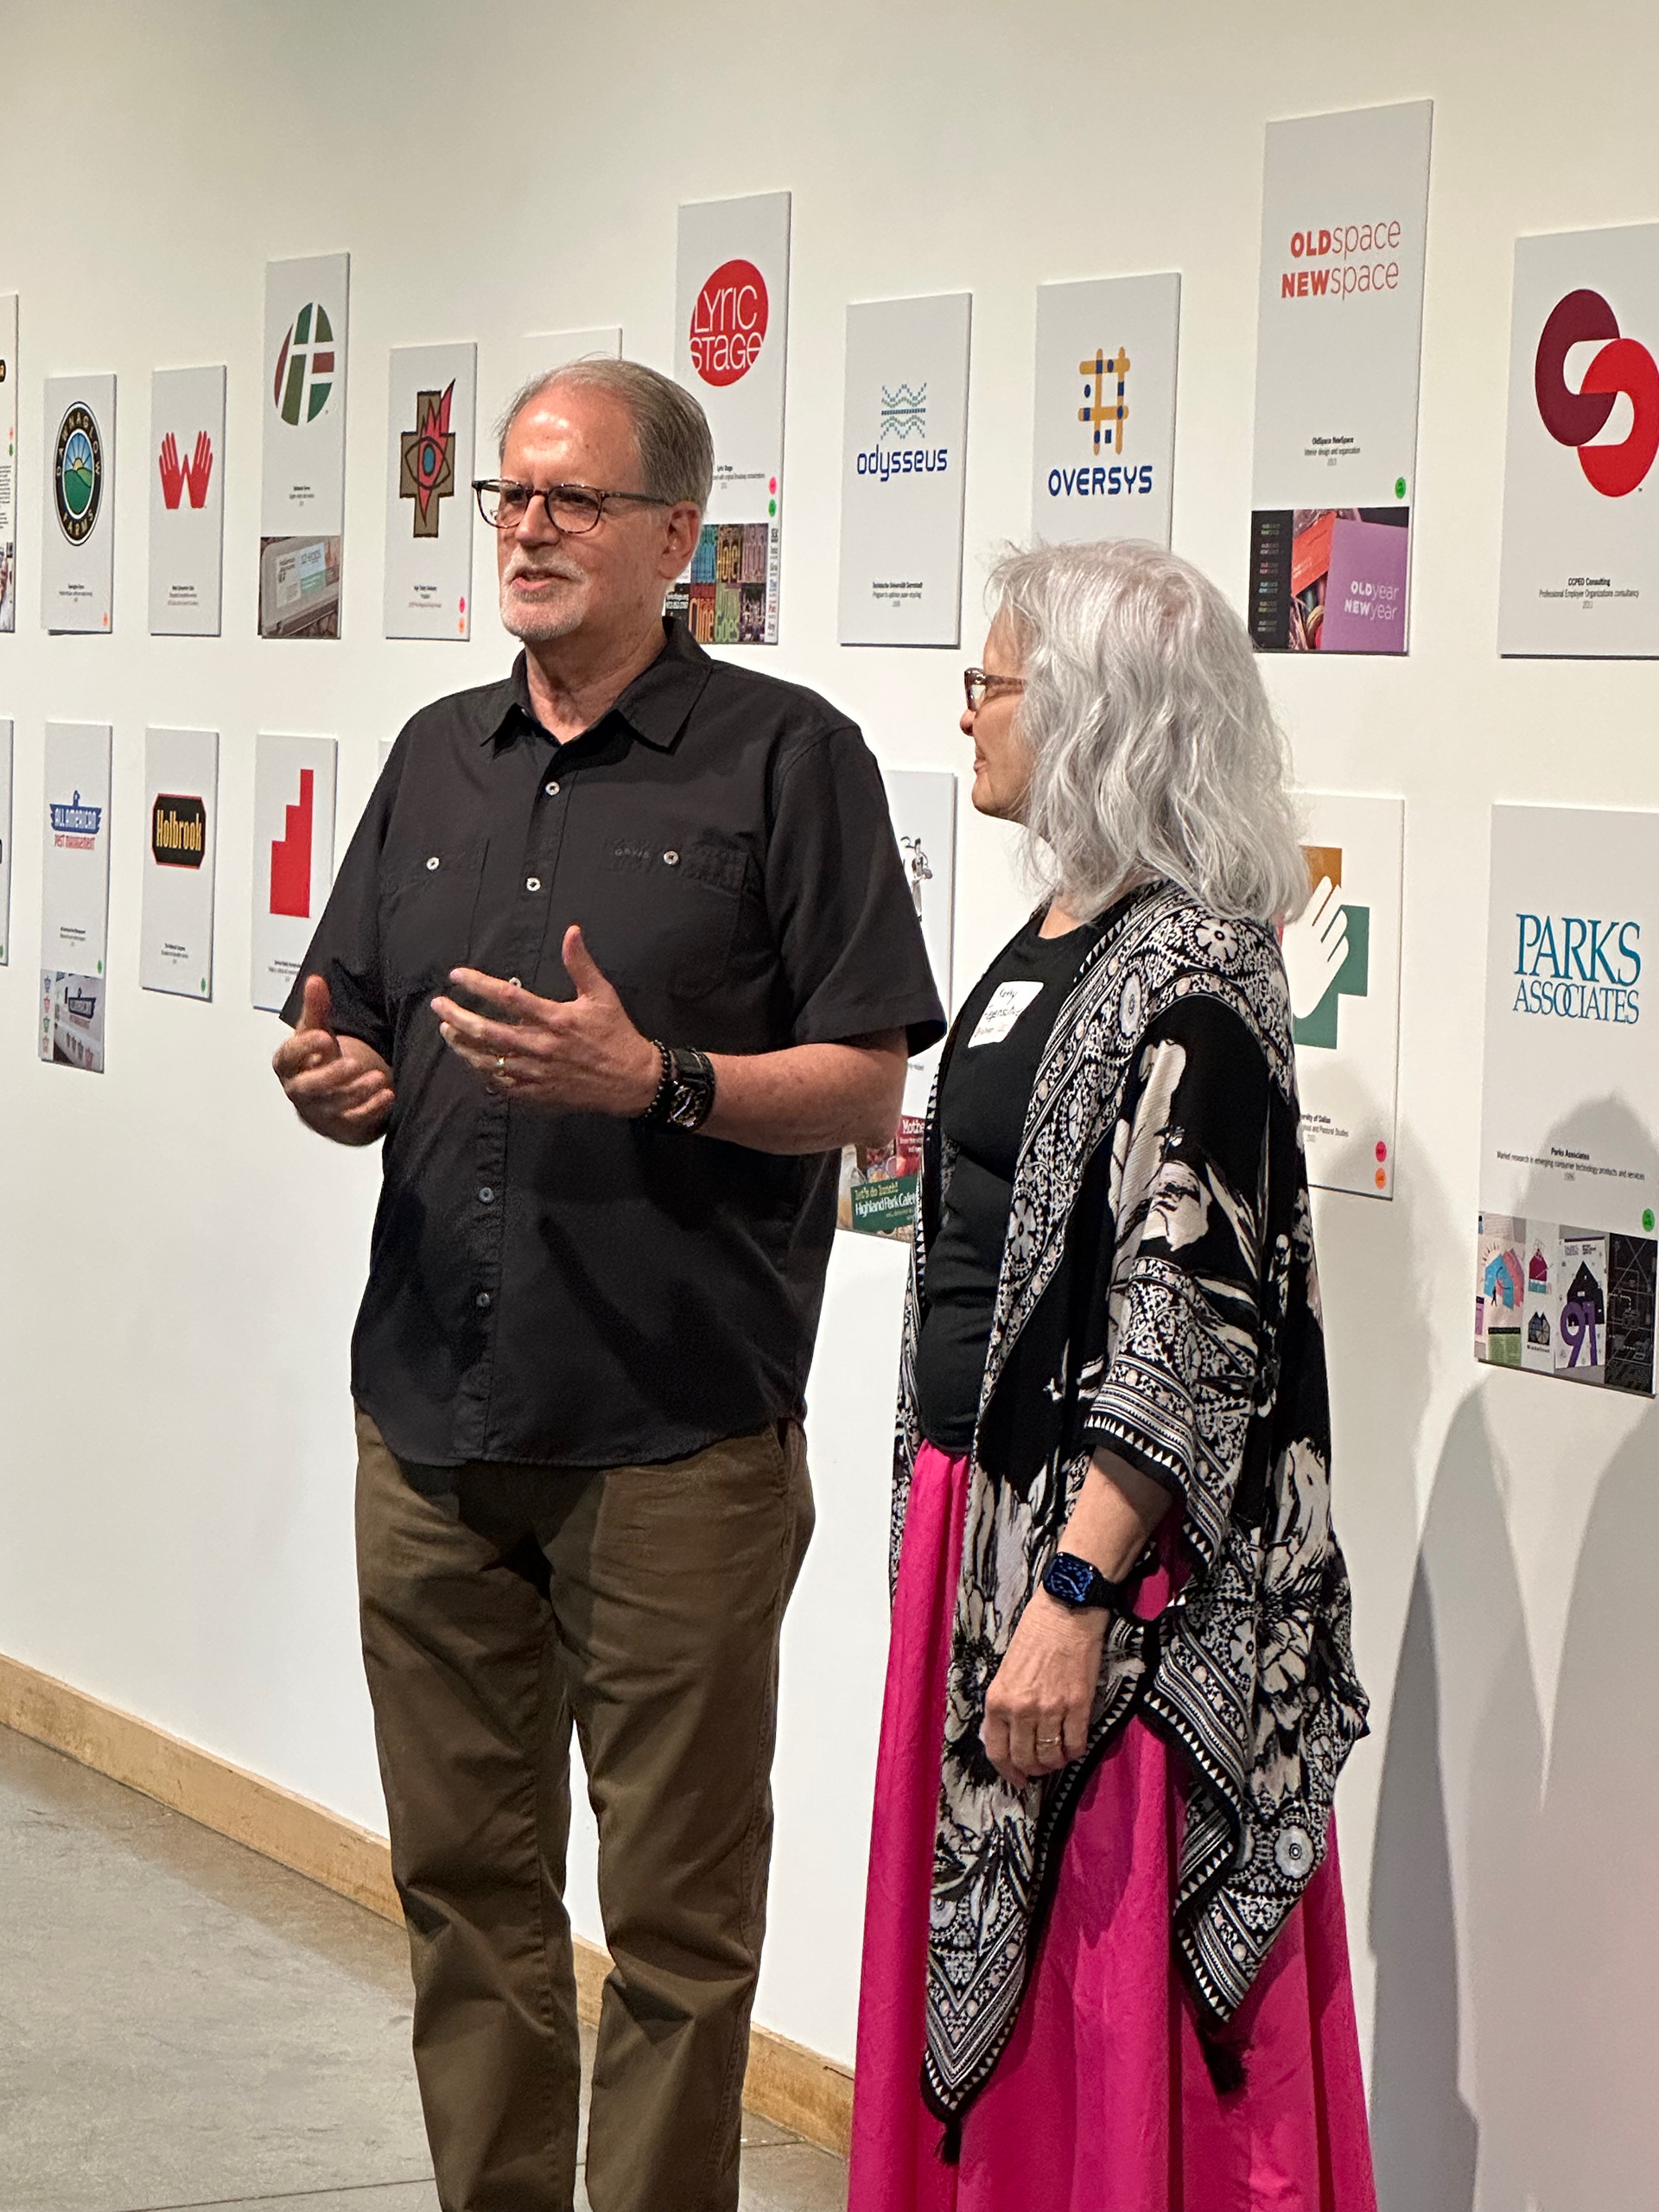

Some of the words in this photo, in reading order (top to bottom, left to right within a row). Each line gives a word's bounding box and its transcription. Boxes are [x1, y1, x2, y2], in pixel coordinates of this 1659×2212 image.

[1291, 220, 1401, 260] OLDspace
[1281, 262, 1399, 301] NEWspace
[857, 444, 948, 482] odysseus
[1048, 465, 1153, 497] OVERSYS
[1351, 581, 1399, 601] OLDyear
[1586, 577, 1611, 587] Consulting
[1344, 599, 1397, 620] NEWyear
[156, 810, 202, 851] Holbrook
[1514, 913, 1641, 987] PARKS
[1512, 979, 1639, 1024] ASSOCIATES
[1551, 1147, 1564, 1157] Parks
[1565, 1149, 1590, 1160] Associates
[855, 1196, 884, 1217] Highland
[884, 1193, 899, 1210] Park
